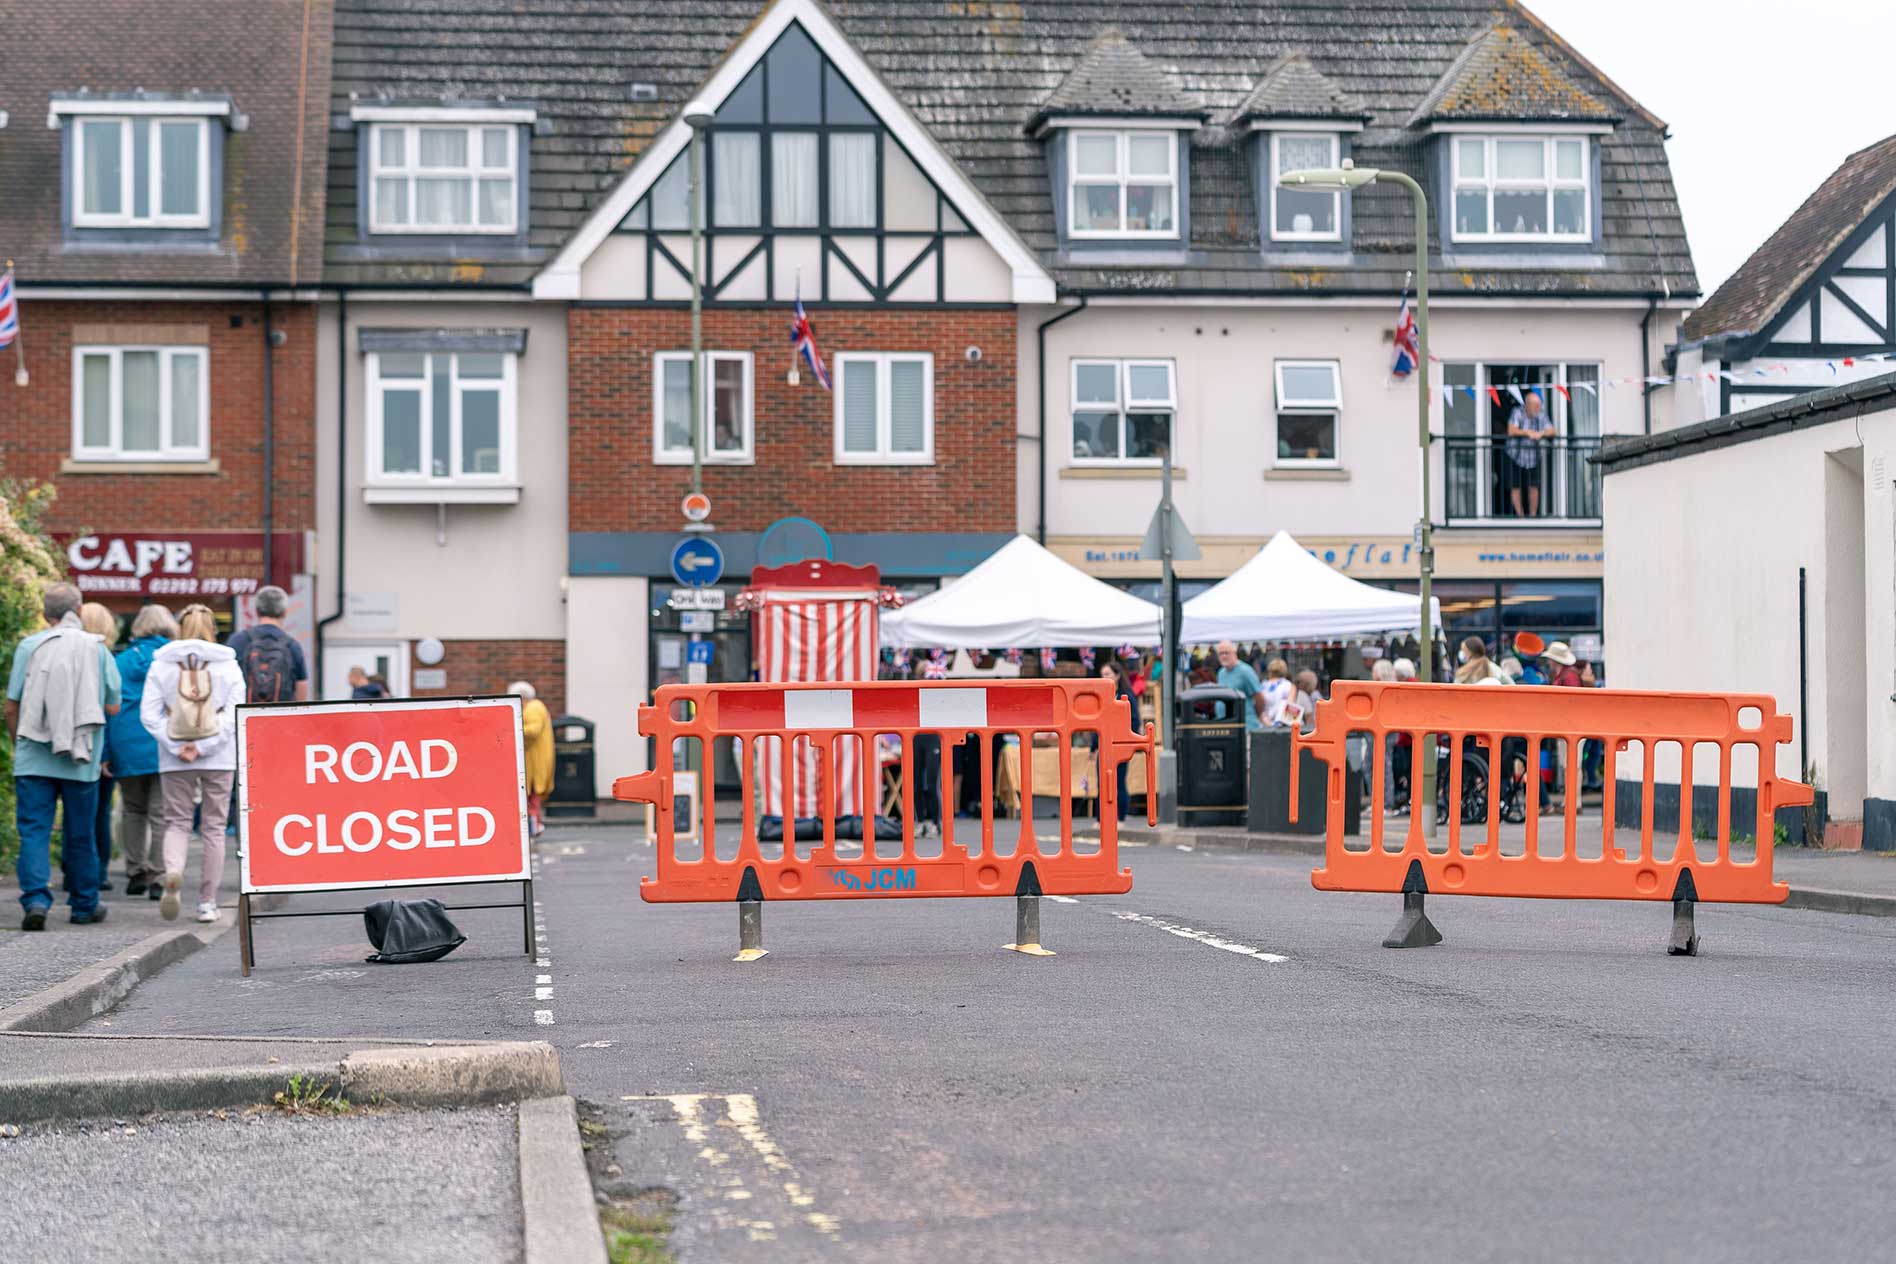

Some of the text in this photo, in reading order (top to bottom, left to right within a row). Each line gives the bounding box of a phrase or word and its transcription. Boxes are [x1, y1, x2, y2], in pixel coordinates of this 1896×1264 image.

[67, 536, 194, 578] CAFE
[305, 739, 458, 784] ROAD
[273, 806, 496, 857] CLOSED
[864, 868, 916, 890] JCM
